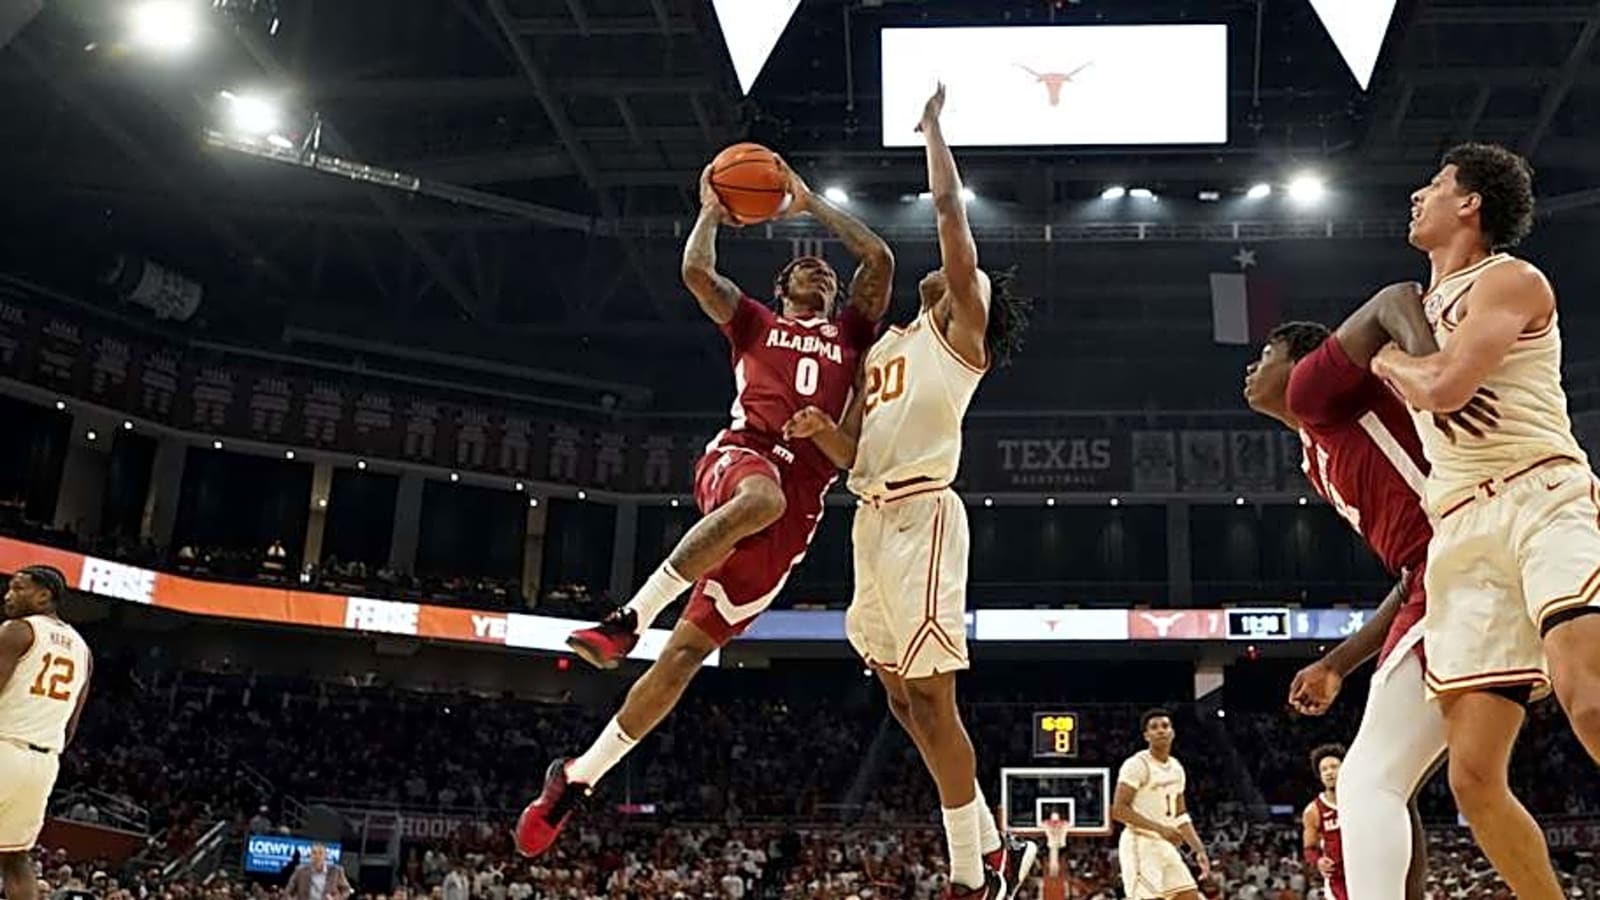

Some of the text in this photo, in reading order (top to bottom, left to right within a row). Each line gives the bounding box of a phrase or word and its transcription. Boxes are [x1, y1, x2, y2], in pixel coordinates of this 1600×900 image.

[794, 356, 820, 397] 0
[864, 355, 906, 416] 20
[996, 438, 1112, 470] TEXAS
[1478, 477, 1497, 498] T
[29, 651, 75, 702] 12
[1055, 731, 1070, 752] 8
